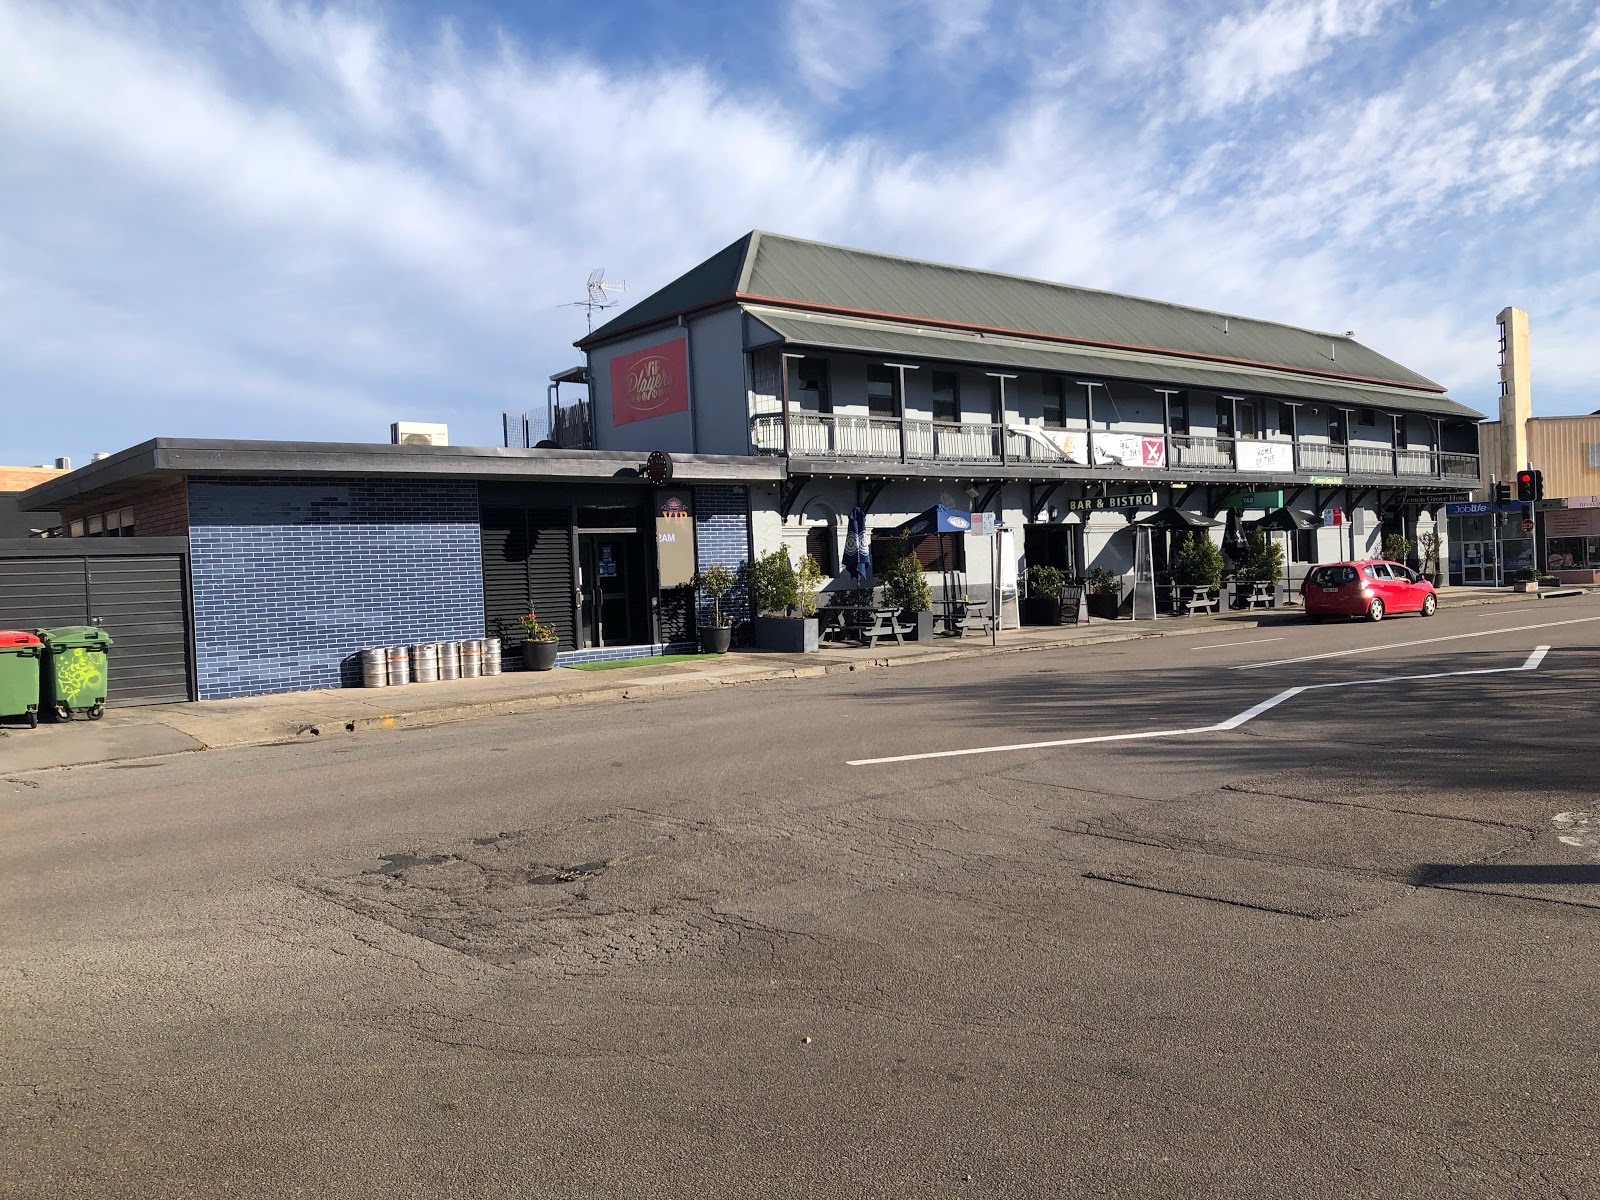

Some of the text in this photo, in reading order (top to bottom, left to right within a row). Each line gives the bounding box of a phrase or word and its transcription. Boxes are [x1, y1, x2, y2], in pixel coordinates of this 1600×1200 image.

[627, 369, 672, 400] Players
[1257, 447, 1273, 457] HOME
[1264, 455, 1275, 463] THE
[1070, 494, 1151, 511] BAR & BISTRO
[1403, 494, 1469, 504] Lemon Grove Hotel
[1454, 503, 1487, 514] Joblife
[662, 510, 688, 524] VIP
